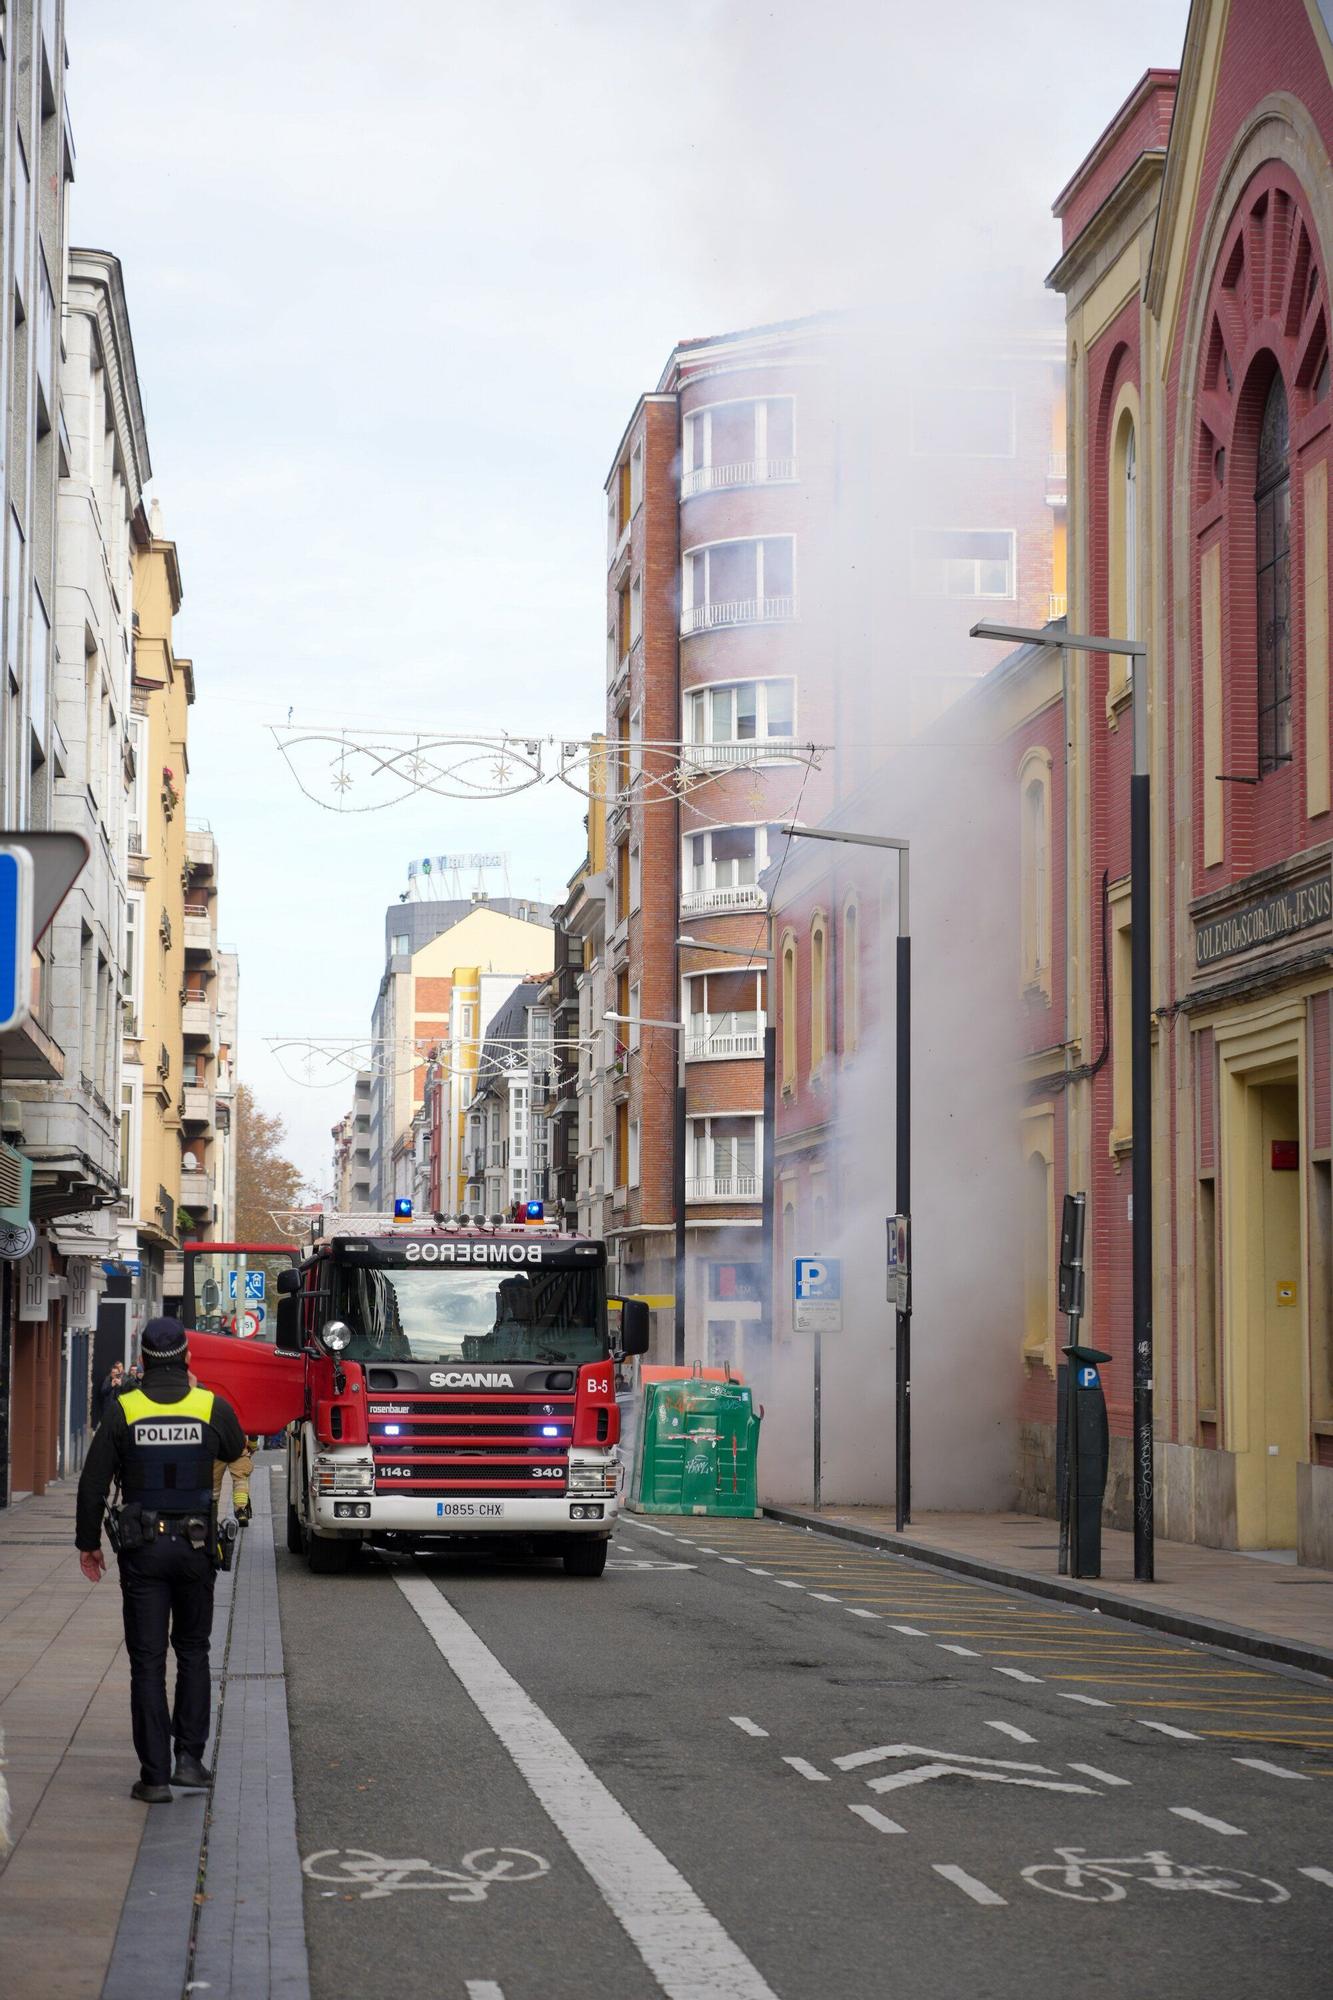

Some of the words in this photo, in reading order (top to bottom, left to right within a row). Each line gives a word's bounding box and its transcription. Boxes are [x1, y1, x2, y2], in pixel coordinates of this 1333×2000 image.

[1196, 918, 1239, 961] COLEGIO
[1292, 881, 1331, 926] JESUS
[801, 1262, 827, 1296] P
[429, 1372, 514, 1388] SCANIA
[1083, 1367, 1097, 1387] P
[587, 1379, 608, 1394] B-5
[369, 1402, 410, 1414] rosenbauer
[136, 1427, 200, 1442] POLIZIA
[532, 1468, 563, 1478] 340
[444, 1503, 475, 1516] 0855
[479, 1503, 502, 1516] CHX
